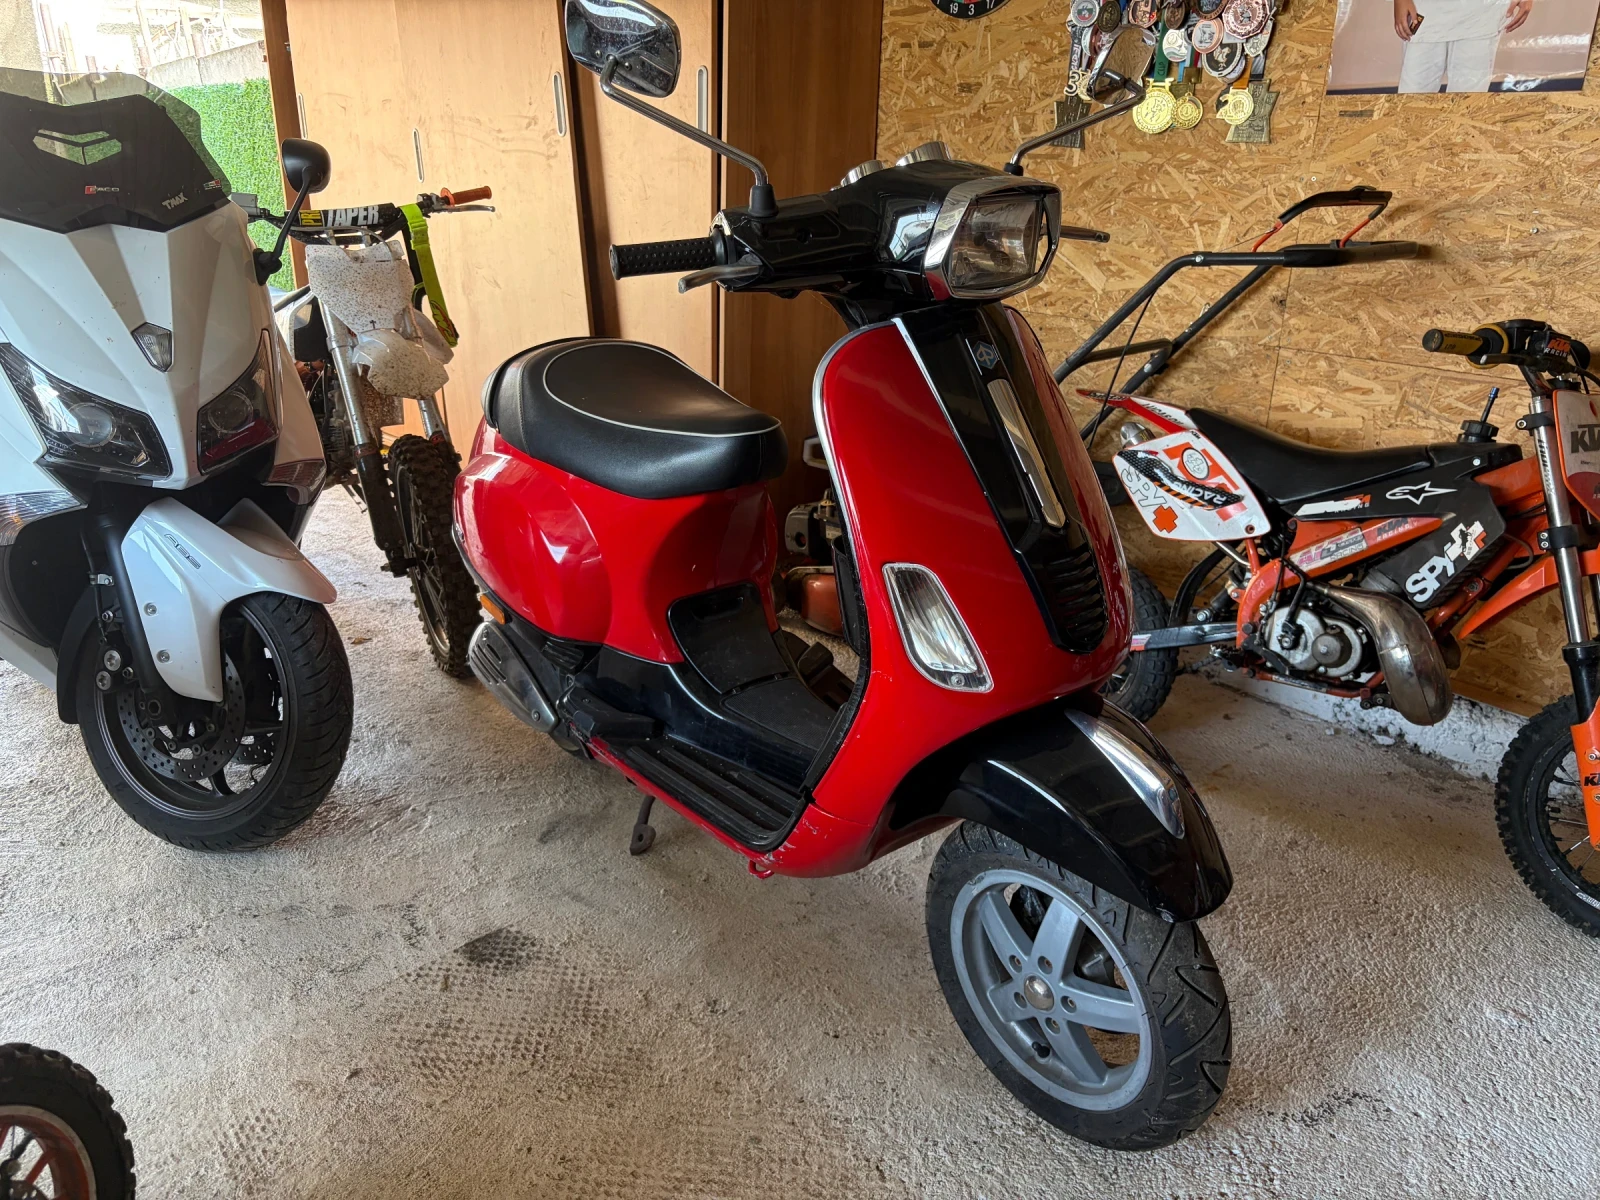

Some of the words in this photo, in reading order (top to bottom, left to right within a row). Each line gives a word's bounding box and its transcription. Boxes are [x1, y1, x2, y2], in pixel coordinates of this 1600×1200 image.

[949, 3, 959, 14] 19
[968, 4, 975, 15] 3
[300, 209, 322, 226] PR
[1543, 347, 1568, 357] RACIN
[1571, 424, 1600, 453] KT
